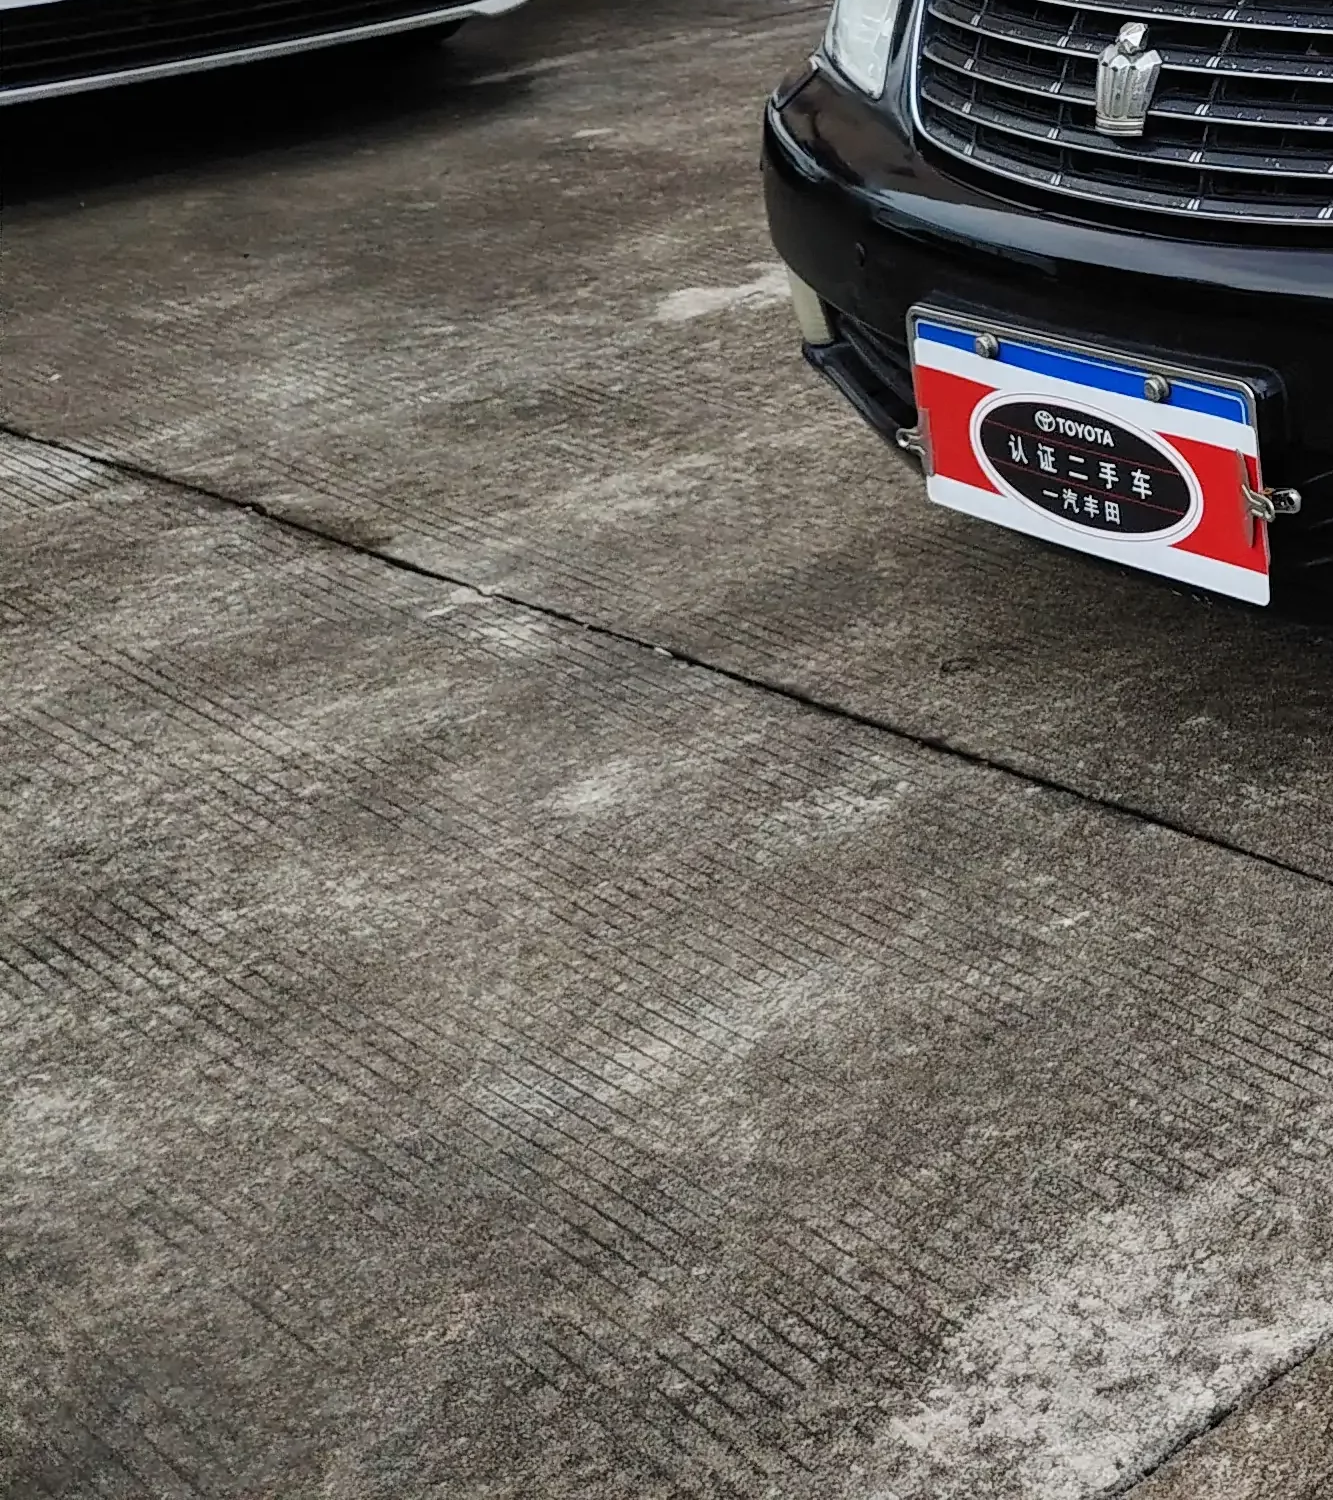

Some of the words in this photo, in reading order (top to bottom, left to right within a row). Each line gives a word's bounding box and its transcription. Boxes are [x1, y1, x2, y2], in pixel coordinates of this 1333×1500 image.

[1056, 417, 1114, 447] TOYOTA
[1007, 434, 1153, 500] 认证二手车
[1043, 488, 1121, 525] 一汽丰田
